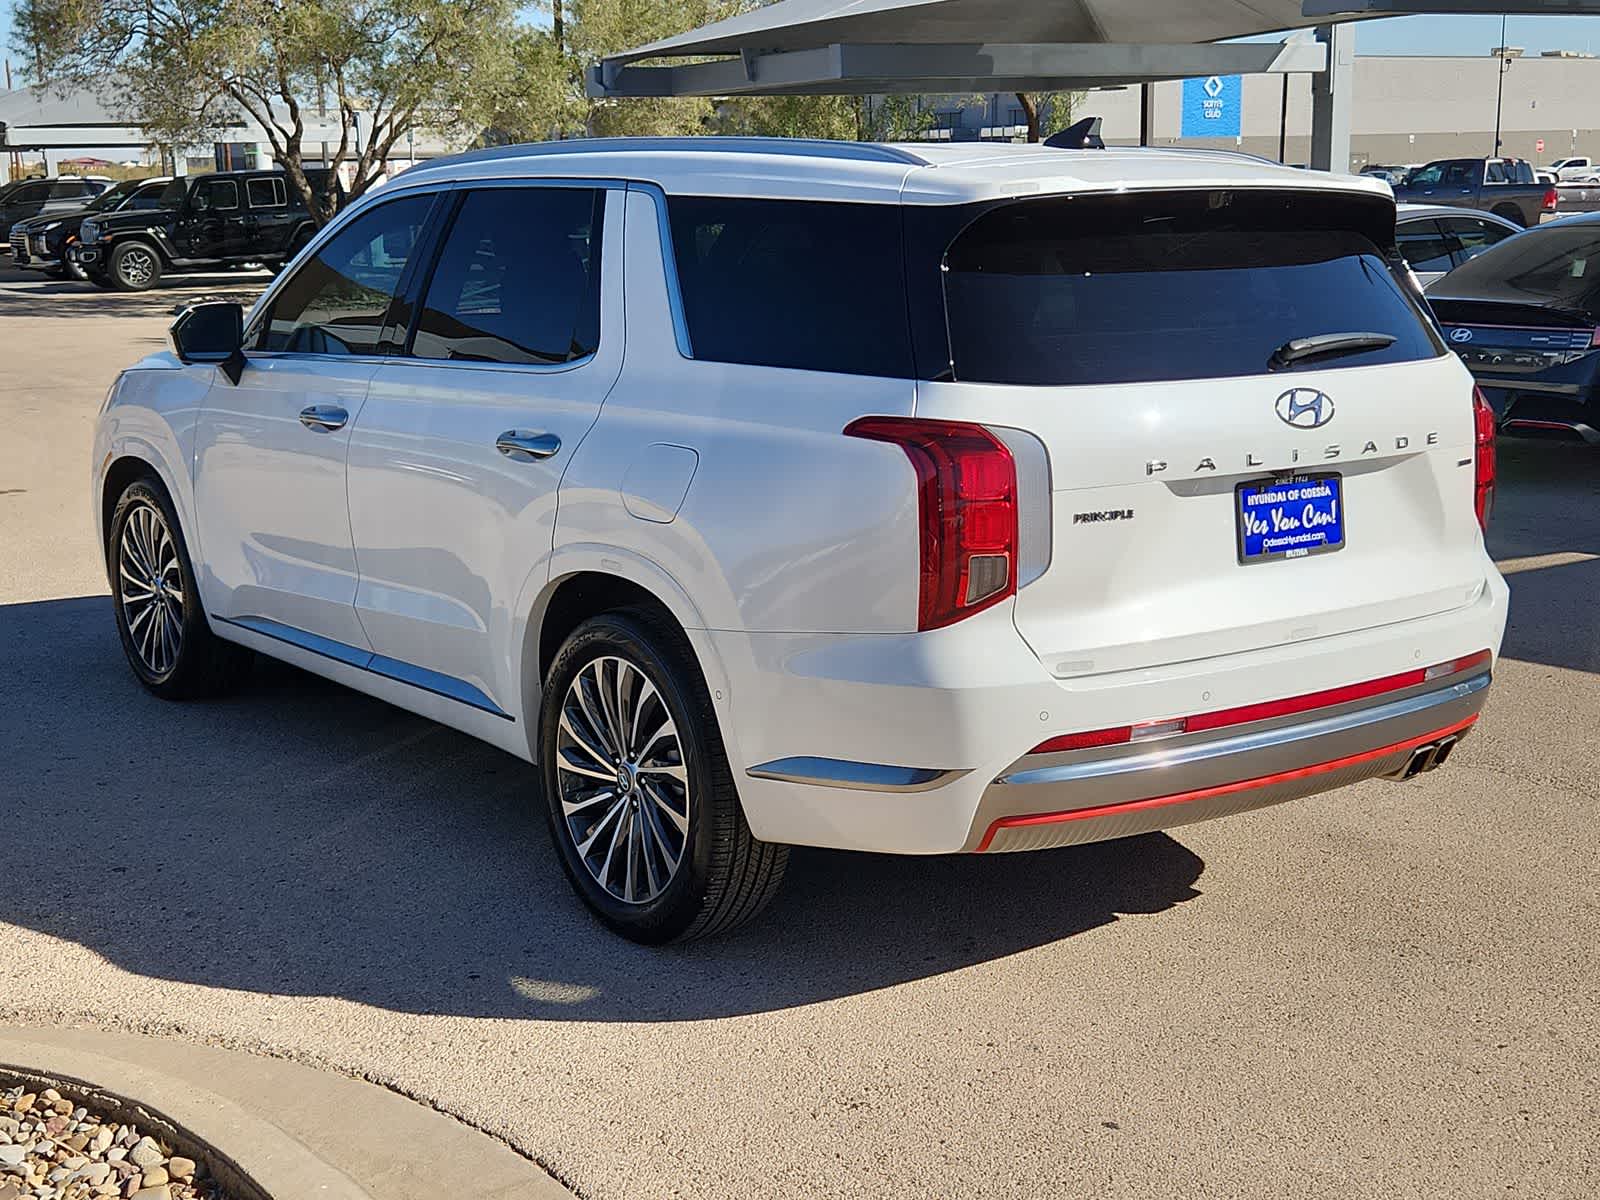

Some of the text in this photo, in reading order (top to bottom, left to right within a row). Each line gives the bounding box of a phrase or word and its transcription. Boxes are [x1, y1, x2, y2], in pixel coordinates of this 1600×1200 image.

[1146, 432, 1438, 476] PALISADE
[1247, 485, 1332, 505] HYUNDAI OF ODESSA
[1072, 508, 1135, 526] PRINCIPLE
[1243, 499, 1337, 536] Yes You Can!
